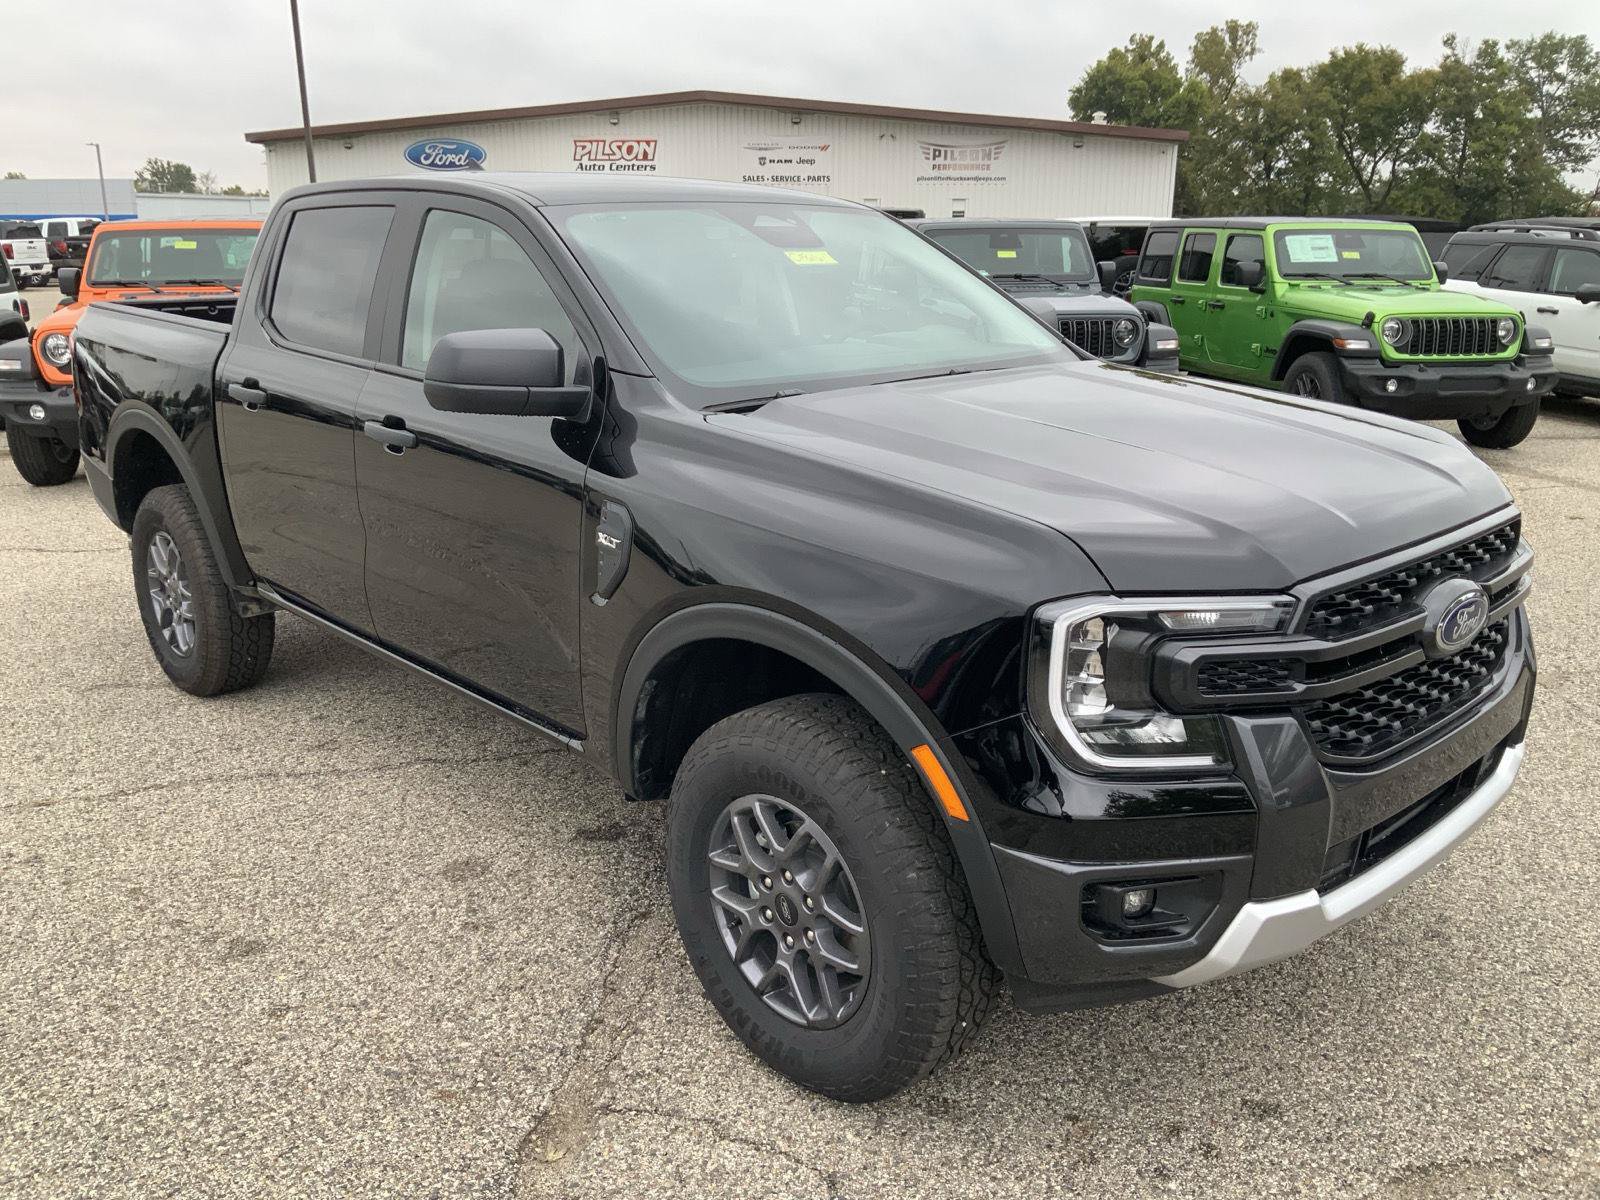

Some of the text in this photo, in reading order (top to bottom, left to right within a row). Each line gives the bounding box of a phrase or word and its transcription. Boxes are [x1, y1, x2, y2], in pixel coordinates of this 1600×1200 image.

[421, 144, 469, 165] Ford
[574, 140, 657, 161] PILSON
[932, 147, 992, 161] PILSON
[576, 163, 656, 171] Auto Centers
[796, 156, 816, 166] Jeep
[597, 532, 621, 549] XLT
[1452, 604, 1482, 640] Ford
